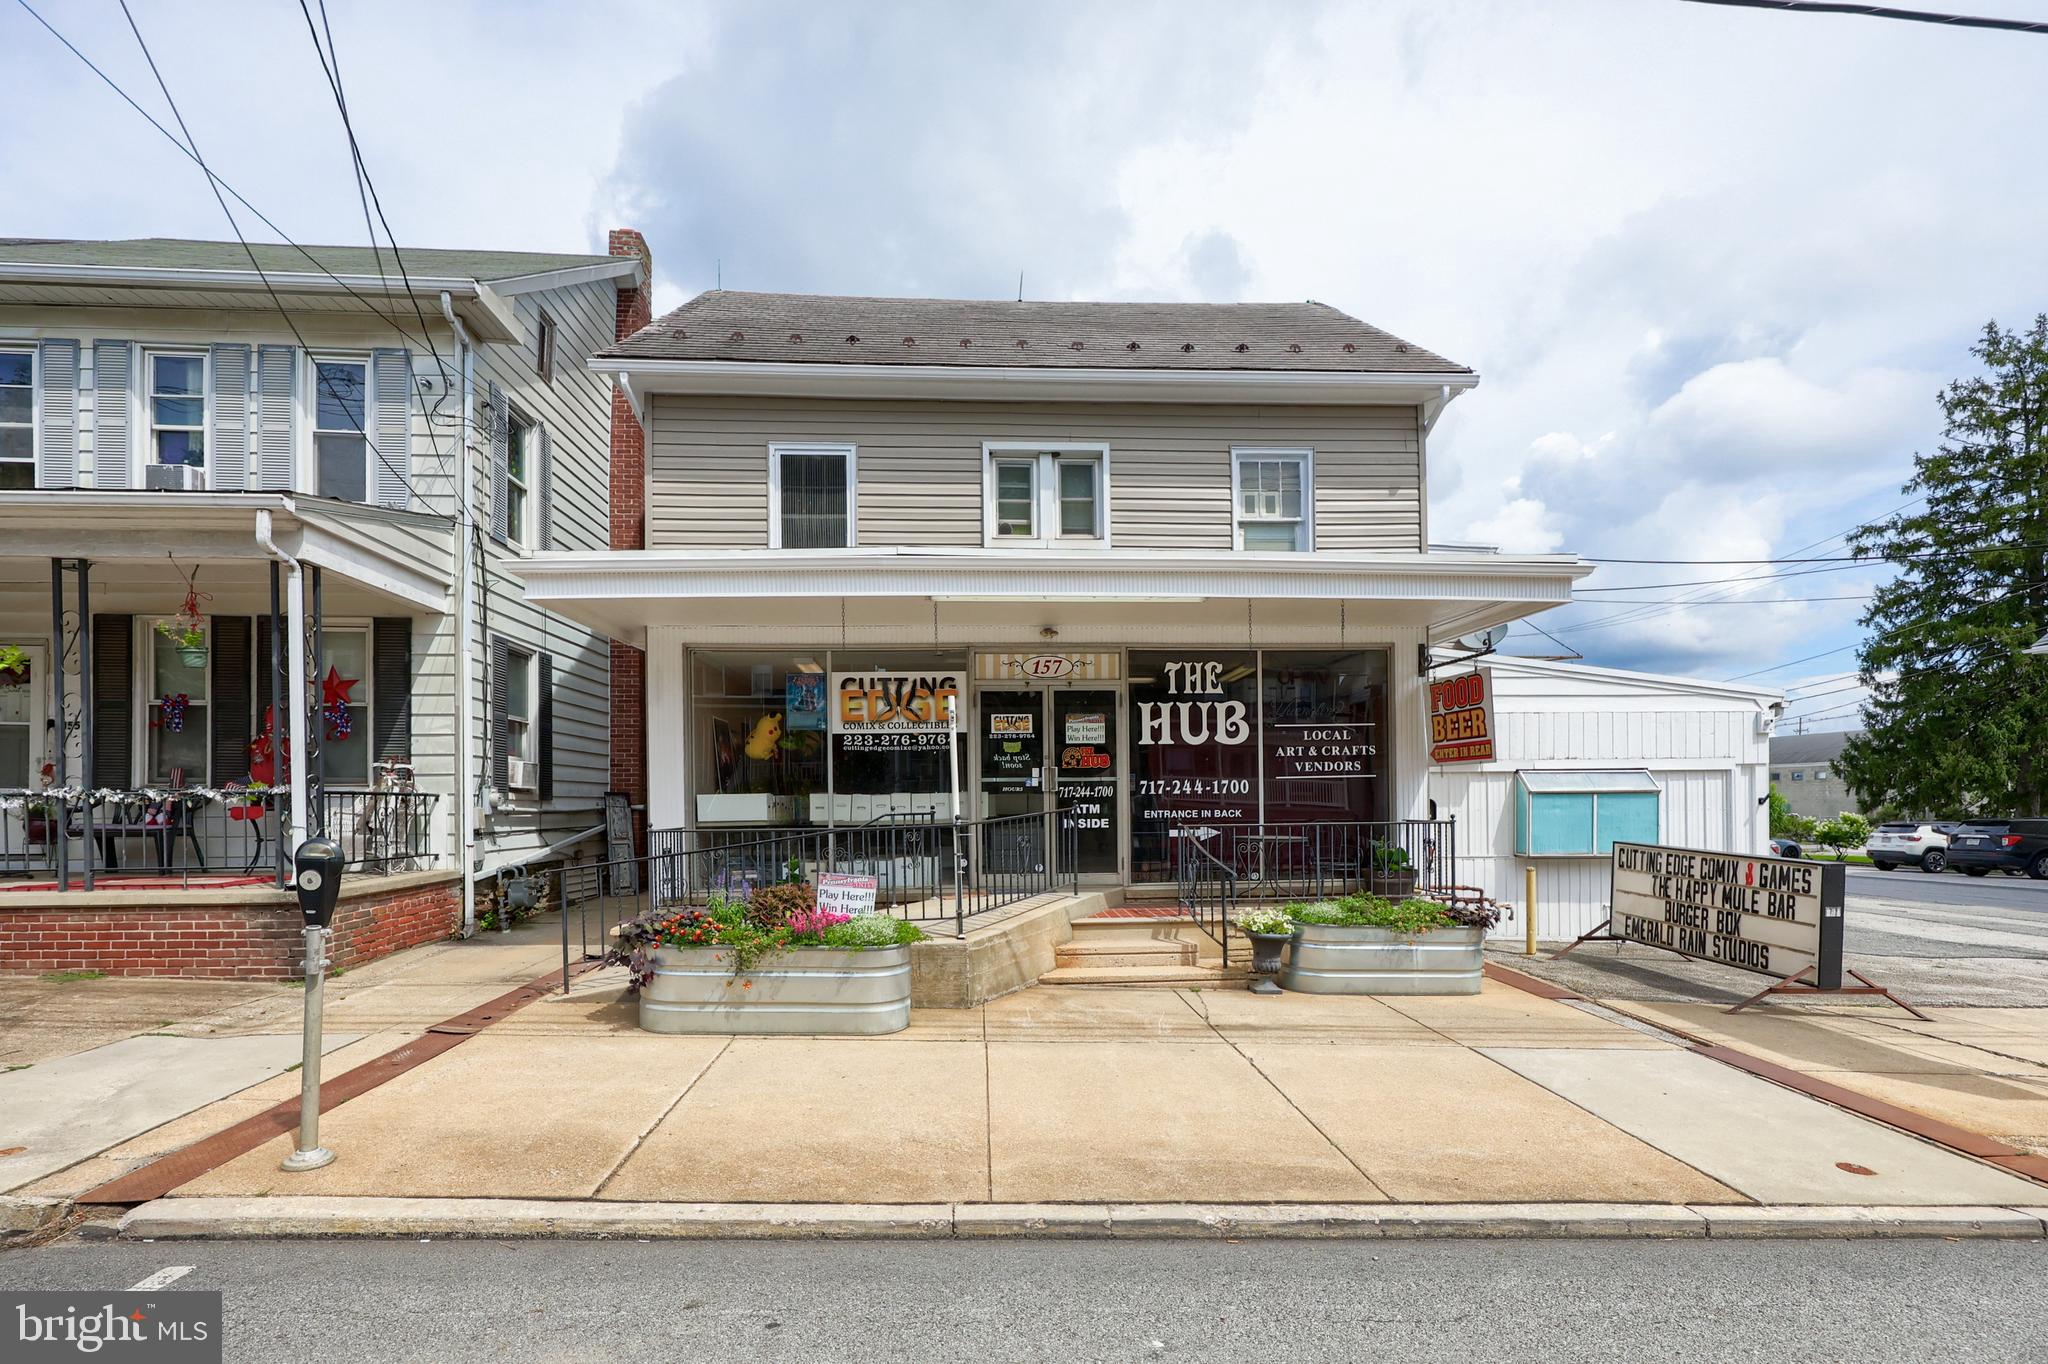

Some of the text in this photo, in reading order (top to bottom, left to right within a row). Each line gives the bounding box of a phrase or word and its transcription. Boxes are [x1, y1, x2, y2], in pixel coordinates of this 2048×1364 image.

[1031, 659, 1063, 675] 157
[1163, 660, 1224, 695] THE
[840, 676, 957, 698] CUTTING
[1429, 673, 1484, 713] FOOD
[839, 688, 959, 722] EDGE
[842, 721, 876, 730] COMIX
[878, 721, 886, 730] &
[993, 715, 1030, 724] CUTTING
[1137, 700, 1250, 746] HUB
[1431, 706, 1488, 744] BEER
[1066, 725, 1080, 733] Play
[1303, 730, 1351, 741] LOCAL
[1275, 745, 1376, 757] ART & CRAFTS
[1435, 743, 1491, 759] ENTER IN REAR
[1080, 754, 1110, 768] HUB
[1295, 760, 1361, 772] VENDORS
[1058, 785, 1114, 798] 717-244-1700
[1139, 779, 1249, 795] 717-244-1700
[1071, 803, 1100, 814] ATM
[1144, 808, 1242, 819] ENTRANCE IN BACK
[1063, 818, 1110, 829] INSIDE
[1617, 848, 1662, 874] CUTTING
[1665, 853, 1696, 879] EDGE
[1699, 857, 1739, 885] COMIX
[1759, 863, 1812, 894] GAMES
[819, 889, 875, 902] Play Here!!!
[1652, 874, 1796, 921] THE HAPPY MULE BAR
[819, 902, 873, 914] Win Here!!!
[1664, 901, 1742, 937] BURGER BOX
[1624, 915, 1770, 970] EMERALD RAIN STUDIOS
